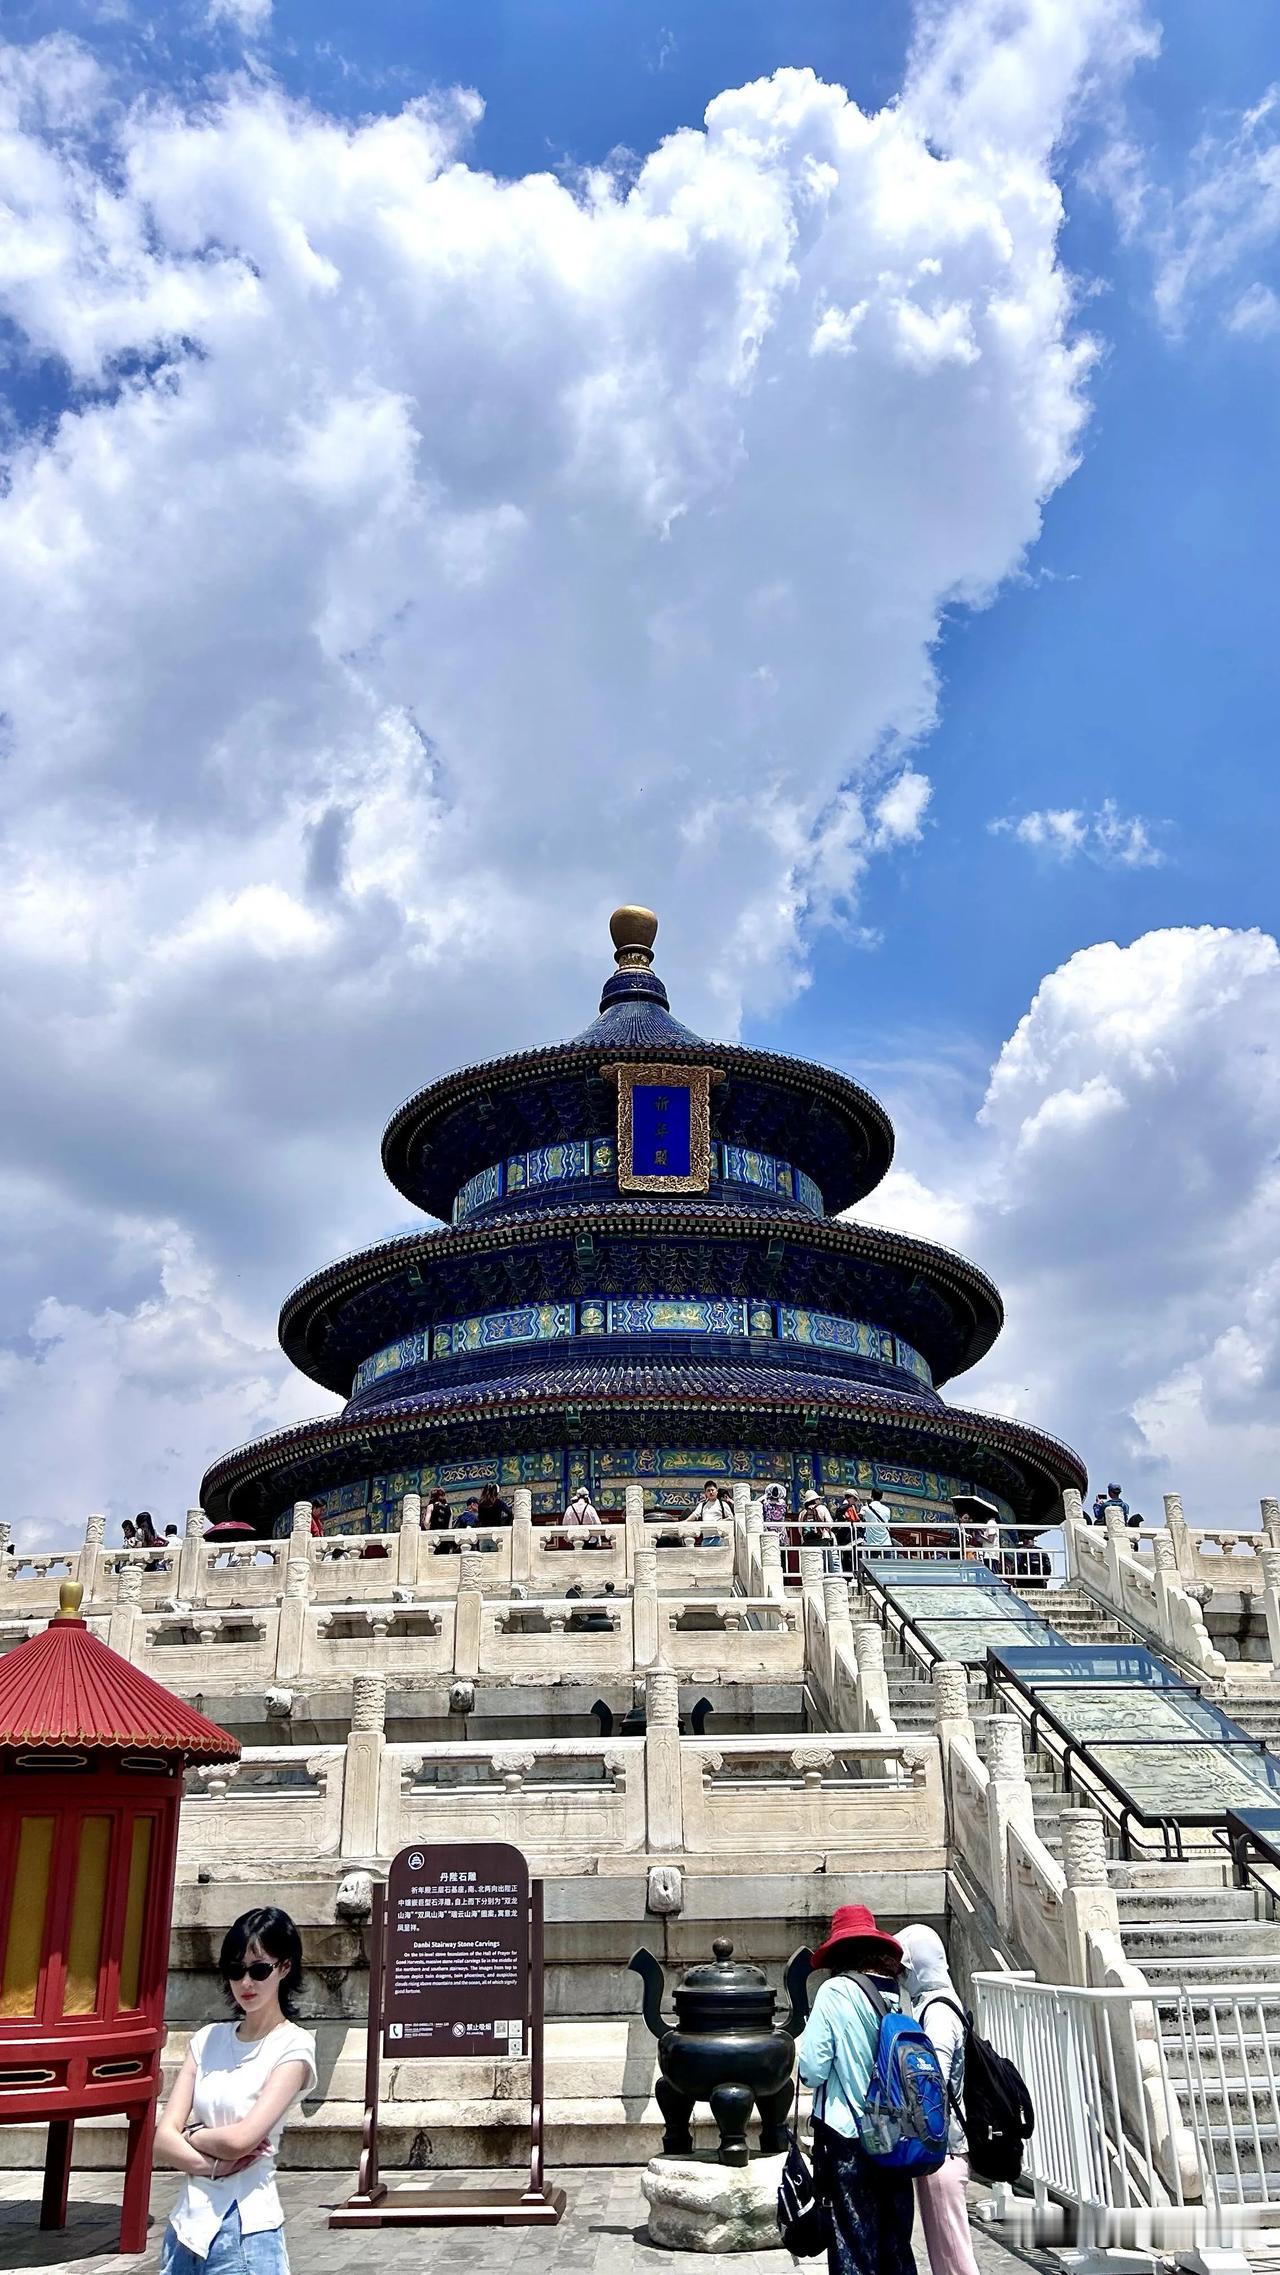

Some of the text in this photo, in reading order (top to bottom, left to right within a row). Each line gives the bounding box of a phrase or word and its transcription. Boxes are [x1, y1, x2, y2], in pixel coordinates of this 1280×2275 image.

[440, 1872, 477, 1882] 丹陛石雕
[432, 1941, 456, 1949] Stairway
[474, 1940, 500, 1948] Carvings
